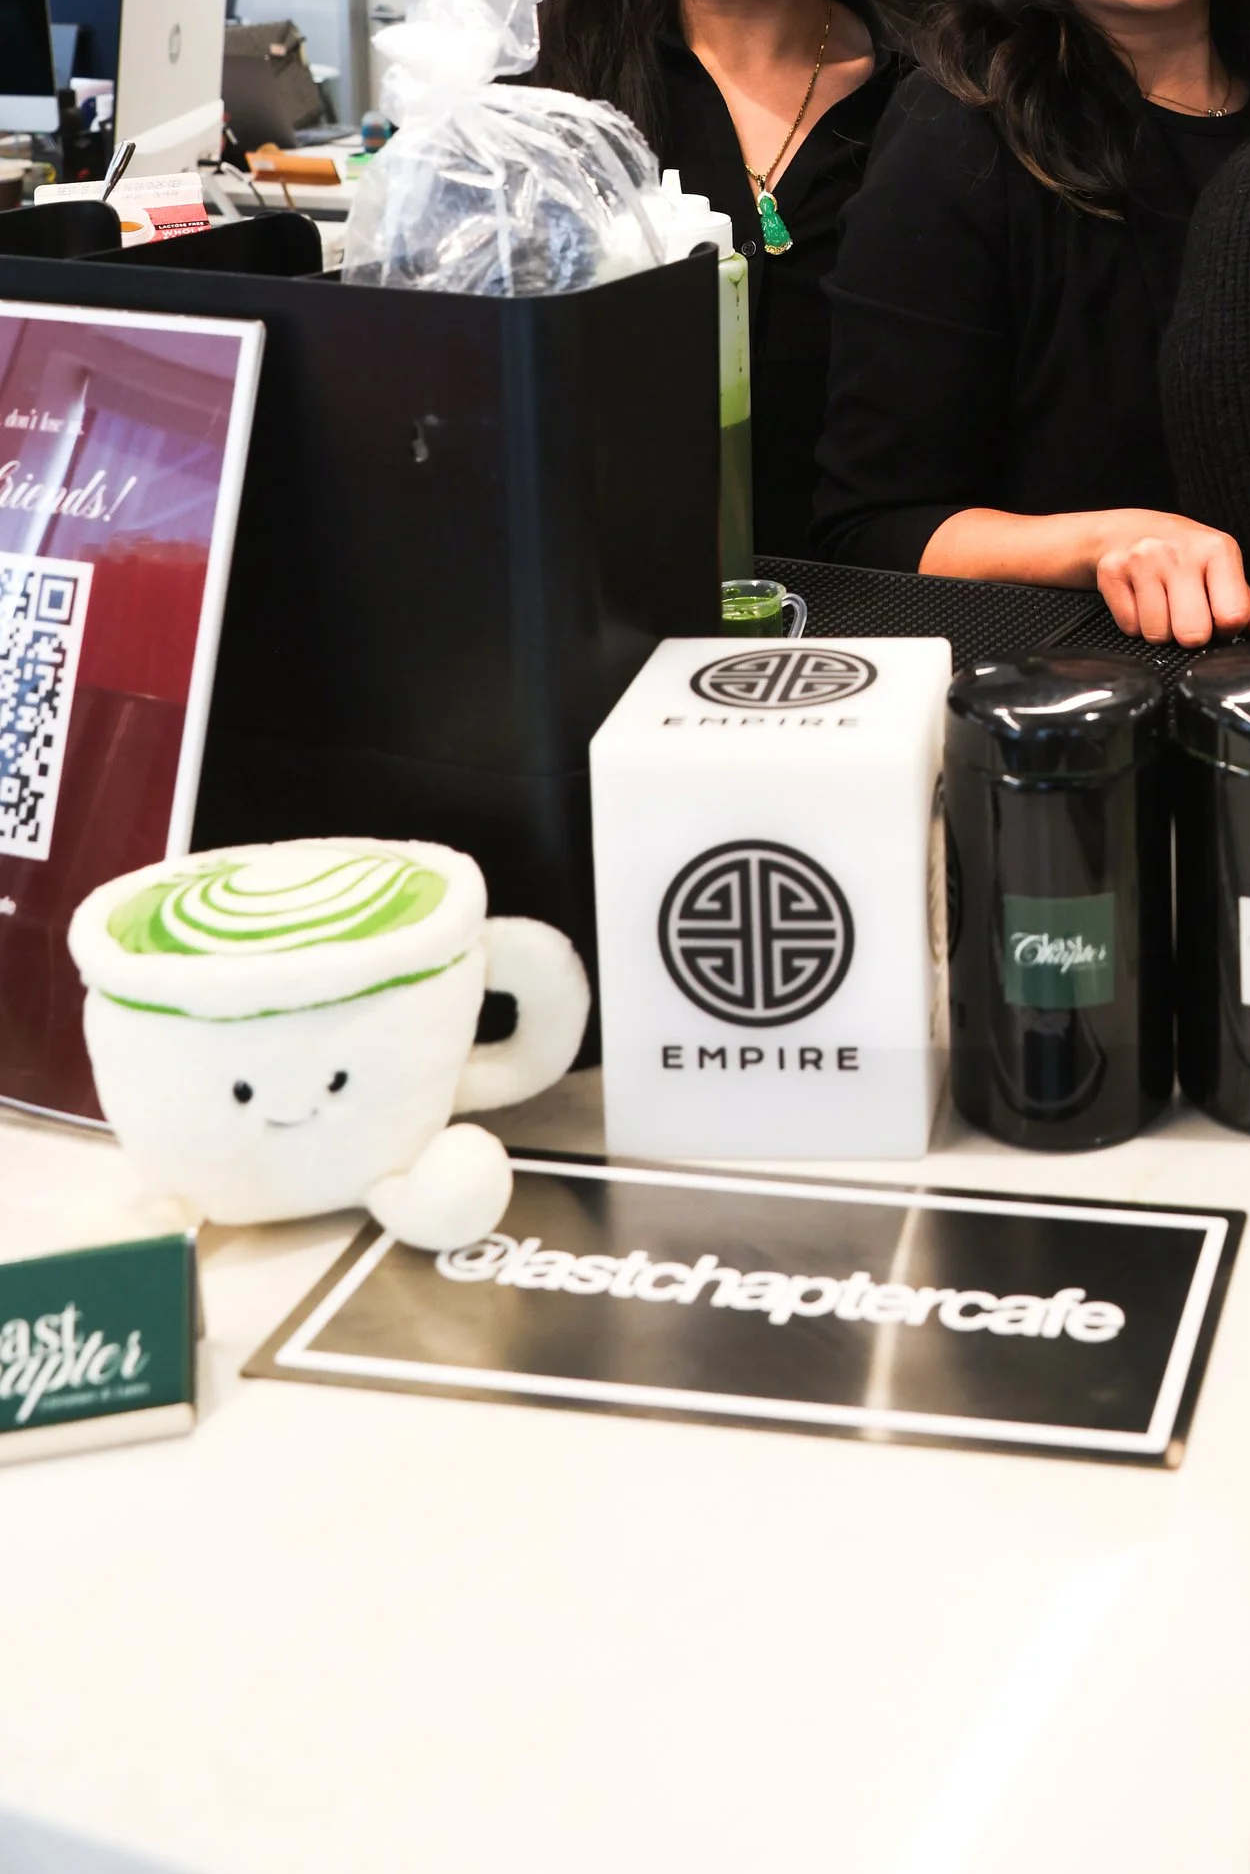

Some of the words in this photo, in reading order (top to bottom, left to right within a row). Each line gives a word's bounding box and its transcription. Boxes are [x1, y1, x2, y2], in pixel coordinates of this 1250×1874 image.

[661, 716, 860, 727] EMPIRE
[661, 1045, 860, 1071] EMPIRE
[434, 1232, 1127, 1343] @lastchaptercafe
[0, 1300, 84, 1364] ast
